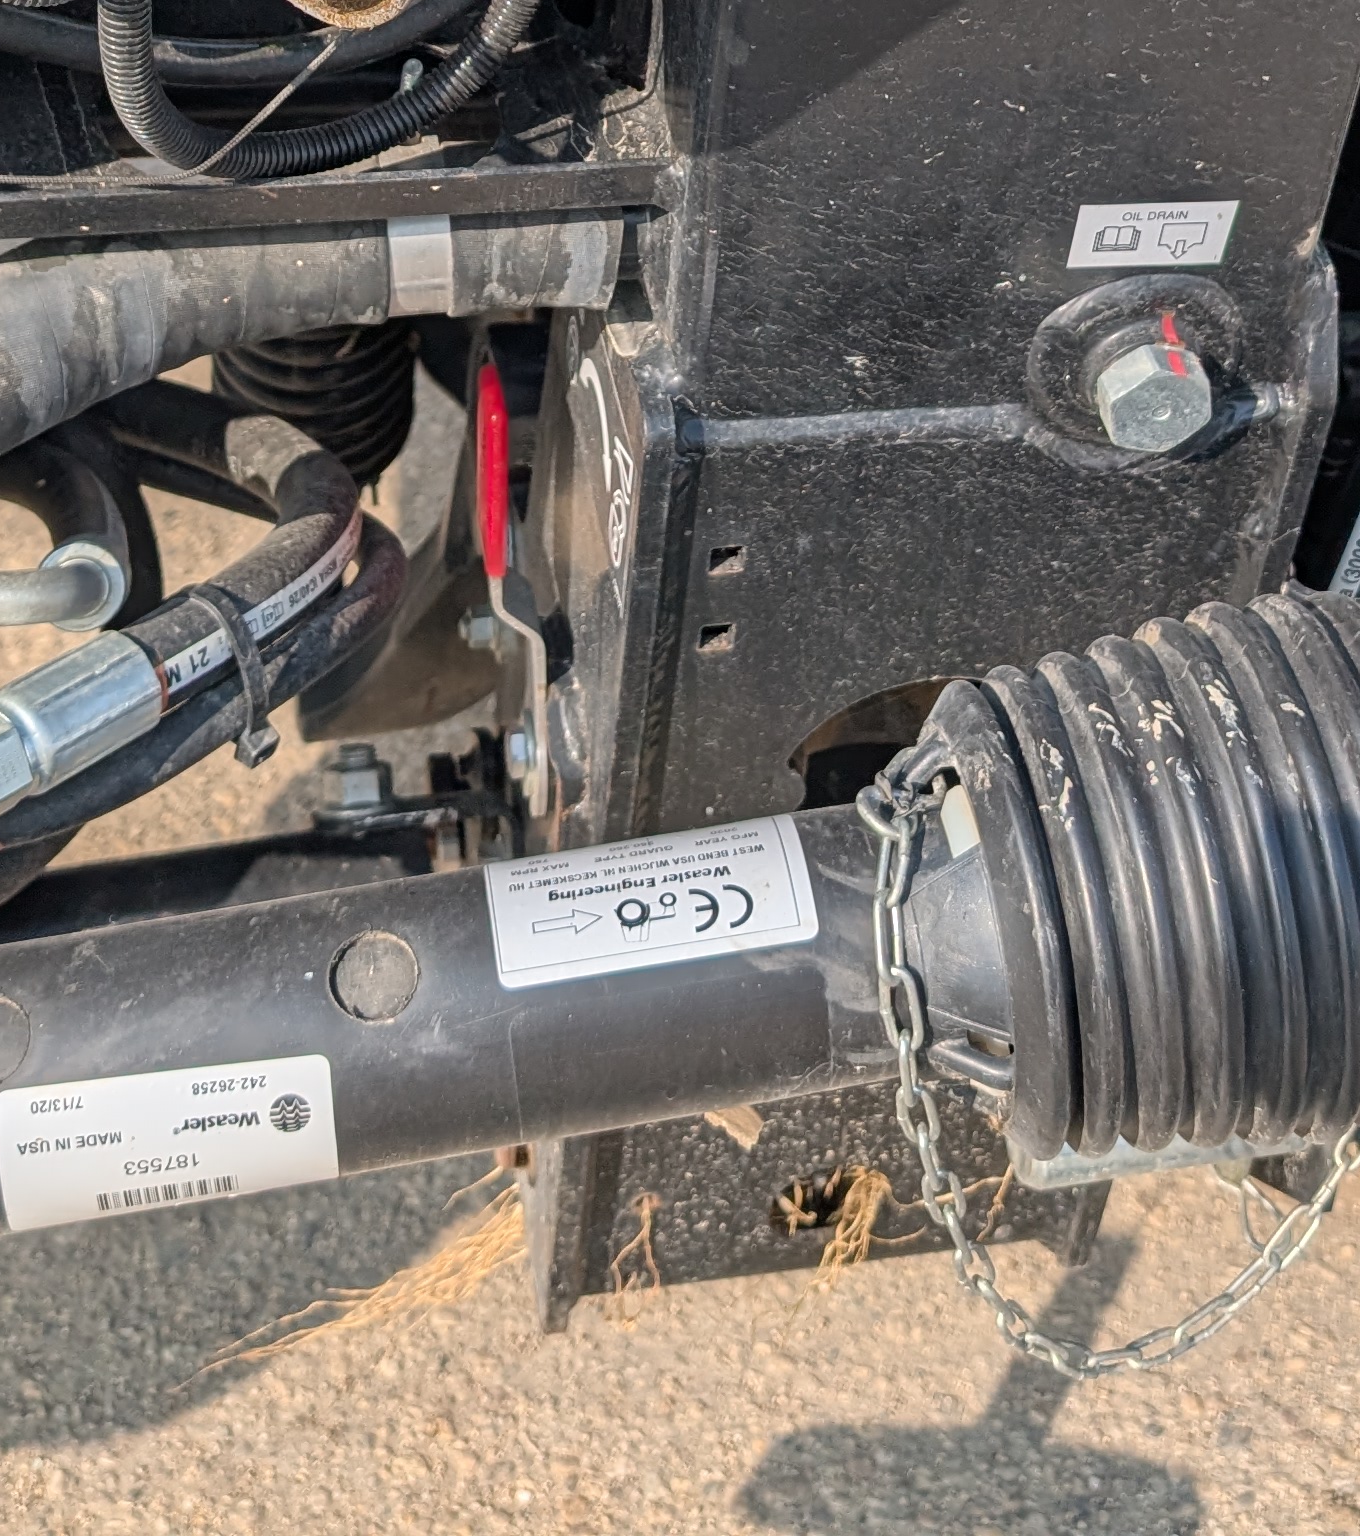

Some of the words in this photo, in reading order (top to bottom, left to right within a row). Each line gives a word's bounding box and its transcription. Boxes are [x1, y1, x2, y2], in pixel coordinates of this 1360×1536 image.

[1122, 211, 1142, 221] OIL
[1147, 210, 1188, 220] DRAIN
[189, 646, 211, 673] 21
[695, 836, 727, 846] YEAR
[629, 845, 673, 857] GUARD
[698, 850, 729, 861] BEND
[733, 844, 765, 856] WEST
[594, 853, 626, 863] TYPE
[672, 855, 695, 865] USA
[511, 867, 538, 876] RPM
[542, 862, 569, 872] MAX
[601, 868, 615, 876] NL
[618, 859, 670, 874] WIJCHEN
[528, 871, 597, 889] KECSKEMET
[661, 866, 731, 883] Weasler
[509, 883, 525, 892] HU
[548, 877, 656, 901] Engineering
[192, 1075, 266, 1096] 242-26258
[30, 1096, 83, 1115] 7/13/20
[55, 1137, 71, 1151] IN
[75, 1131, 122, 1148] MADE
[17, 1138, 50, 1155] USA
[124, 1153, 200, 1175] 187553
